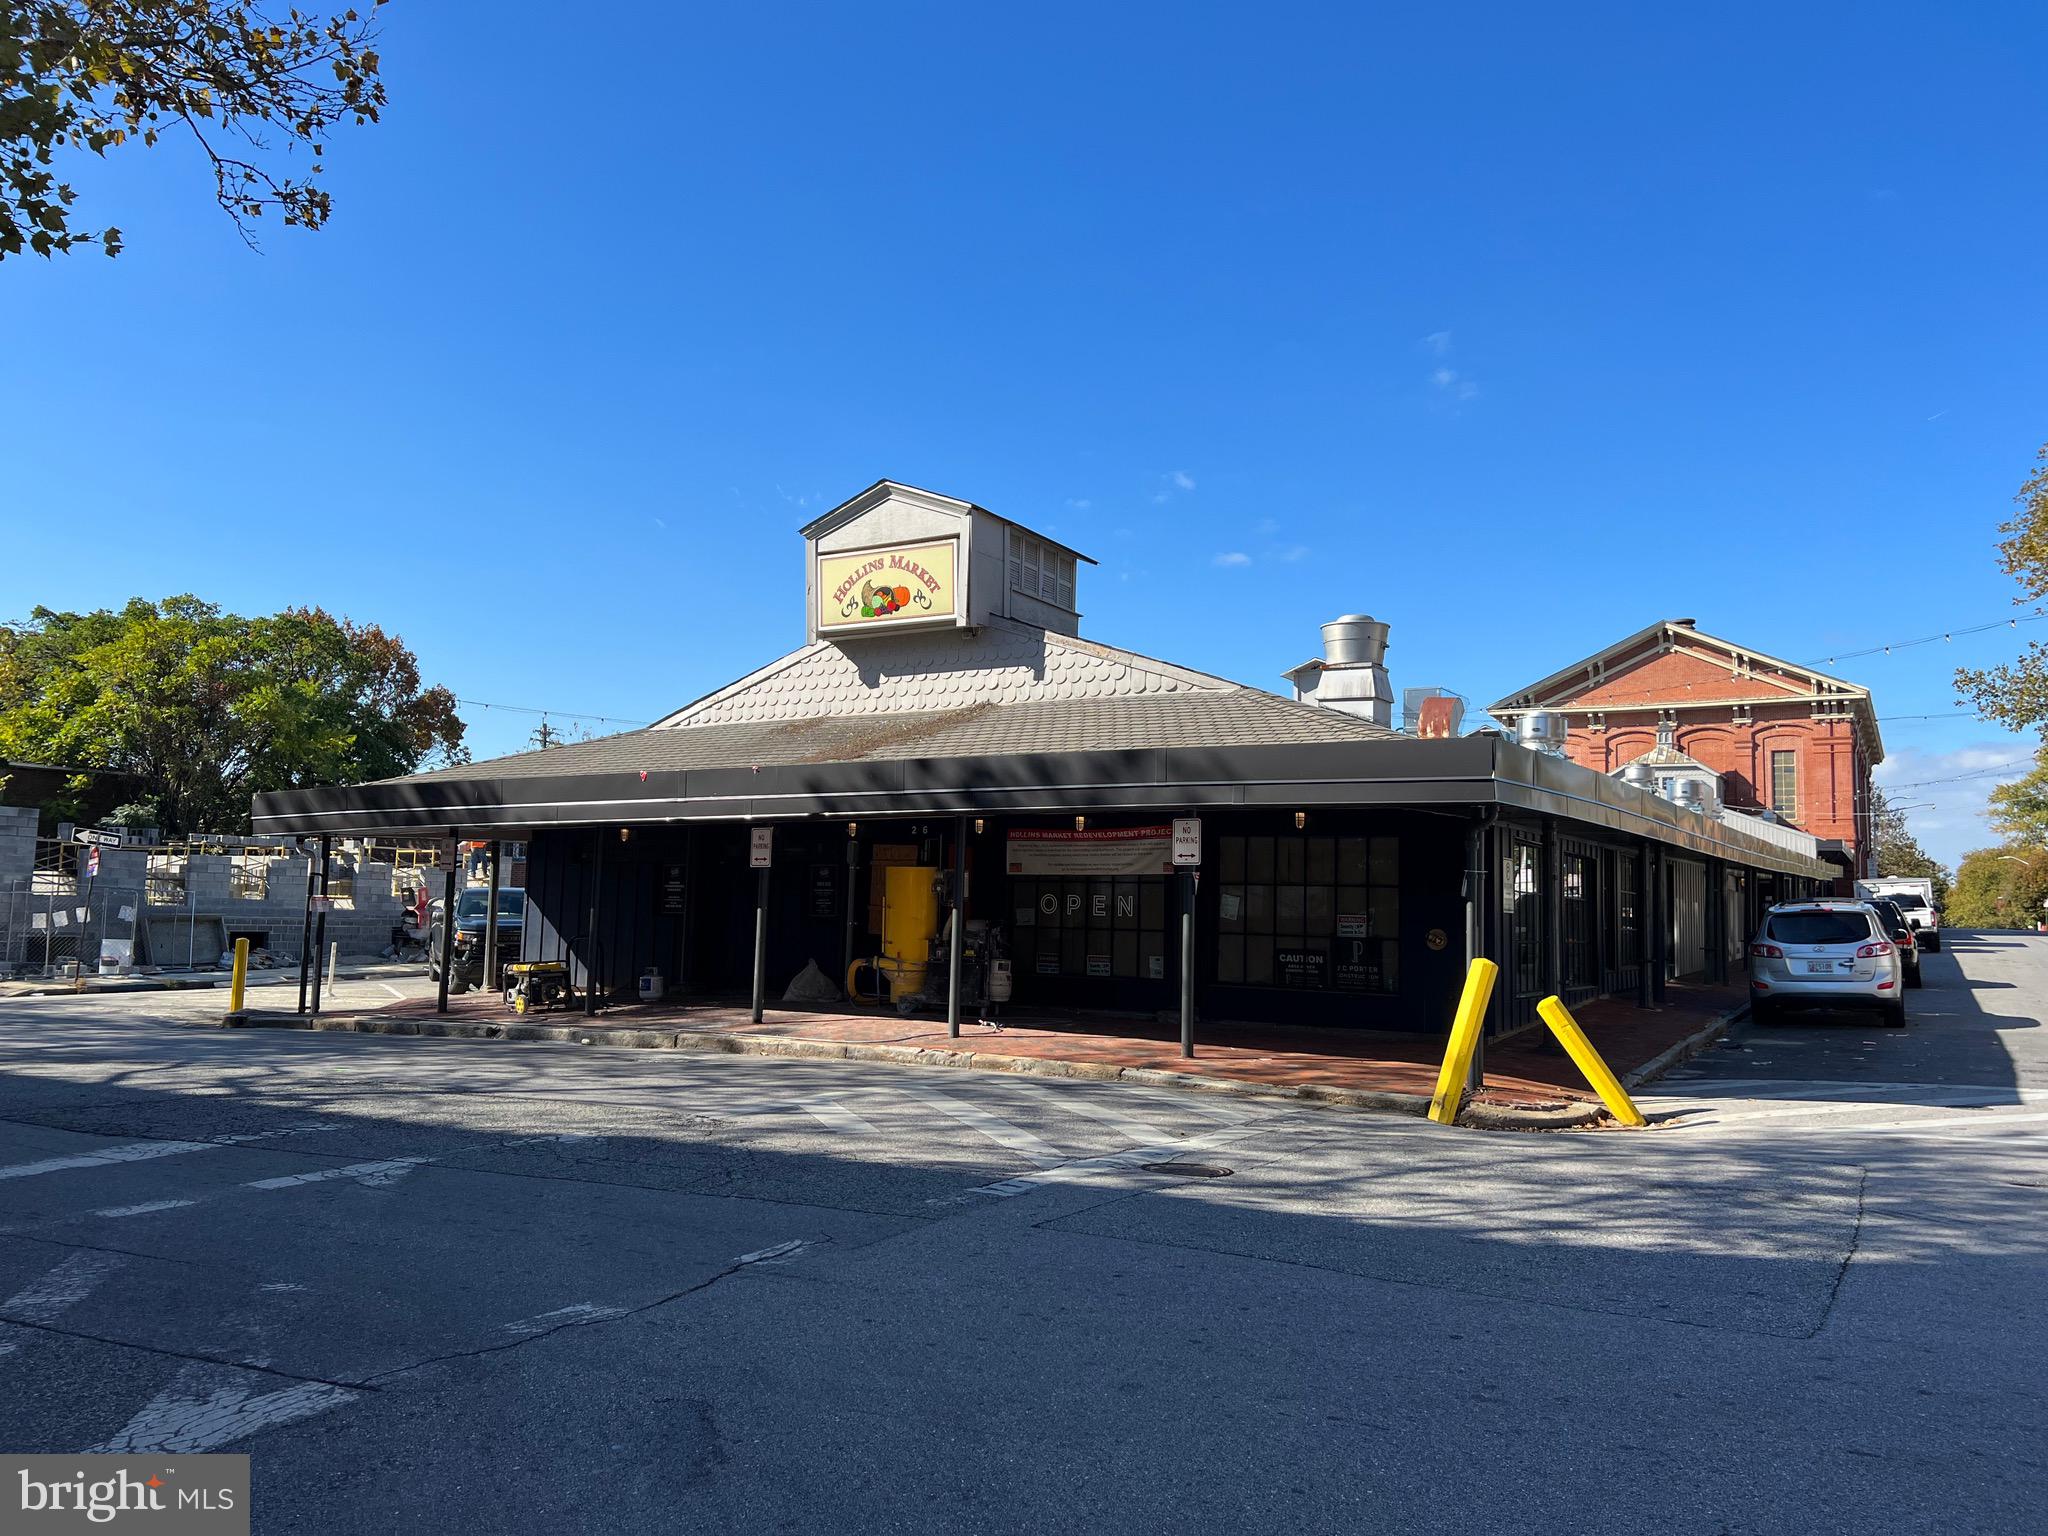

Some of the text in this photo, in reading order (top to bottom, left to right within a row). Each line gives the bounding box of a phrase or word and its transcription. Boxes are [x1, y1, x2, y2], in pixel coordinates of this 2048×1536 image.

[1010, 828, 1172, 839] HOLLINS MARKET REDEVELOPMENT PROJEC
[1182, 826, 1192, 834] NO
[1175, 836, 1198, 845] PARKING
[1040, 893, 1134, 917] OPEN
